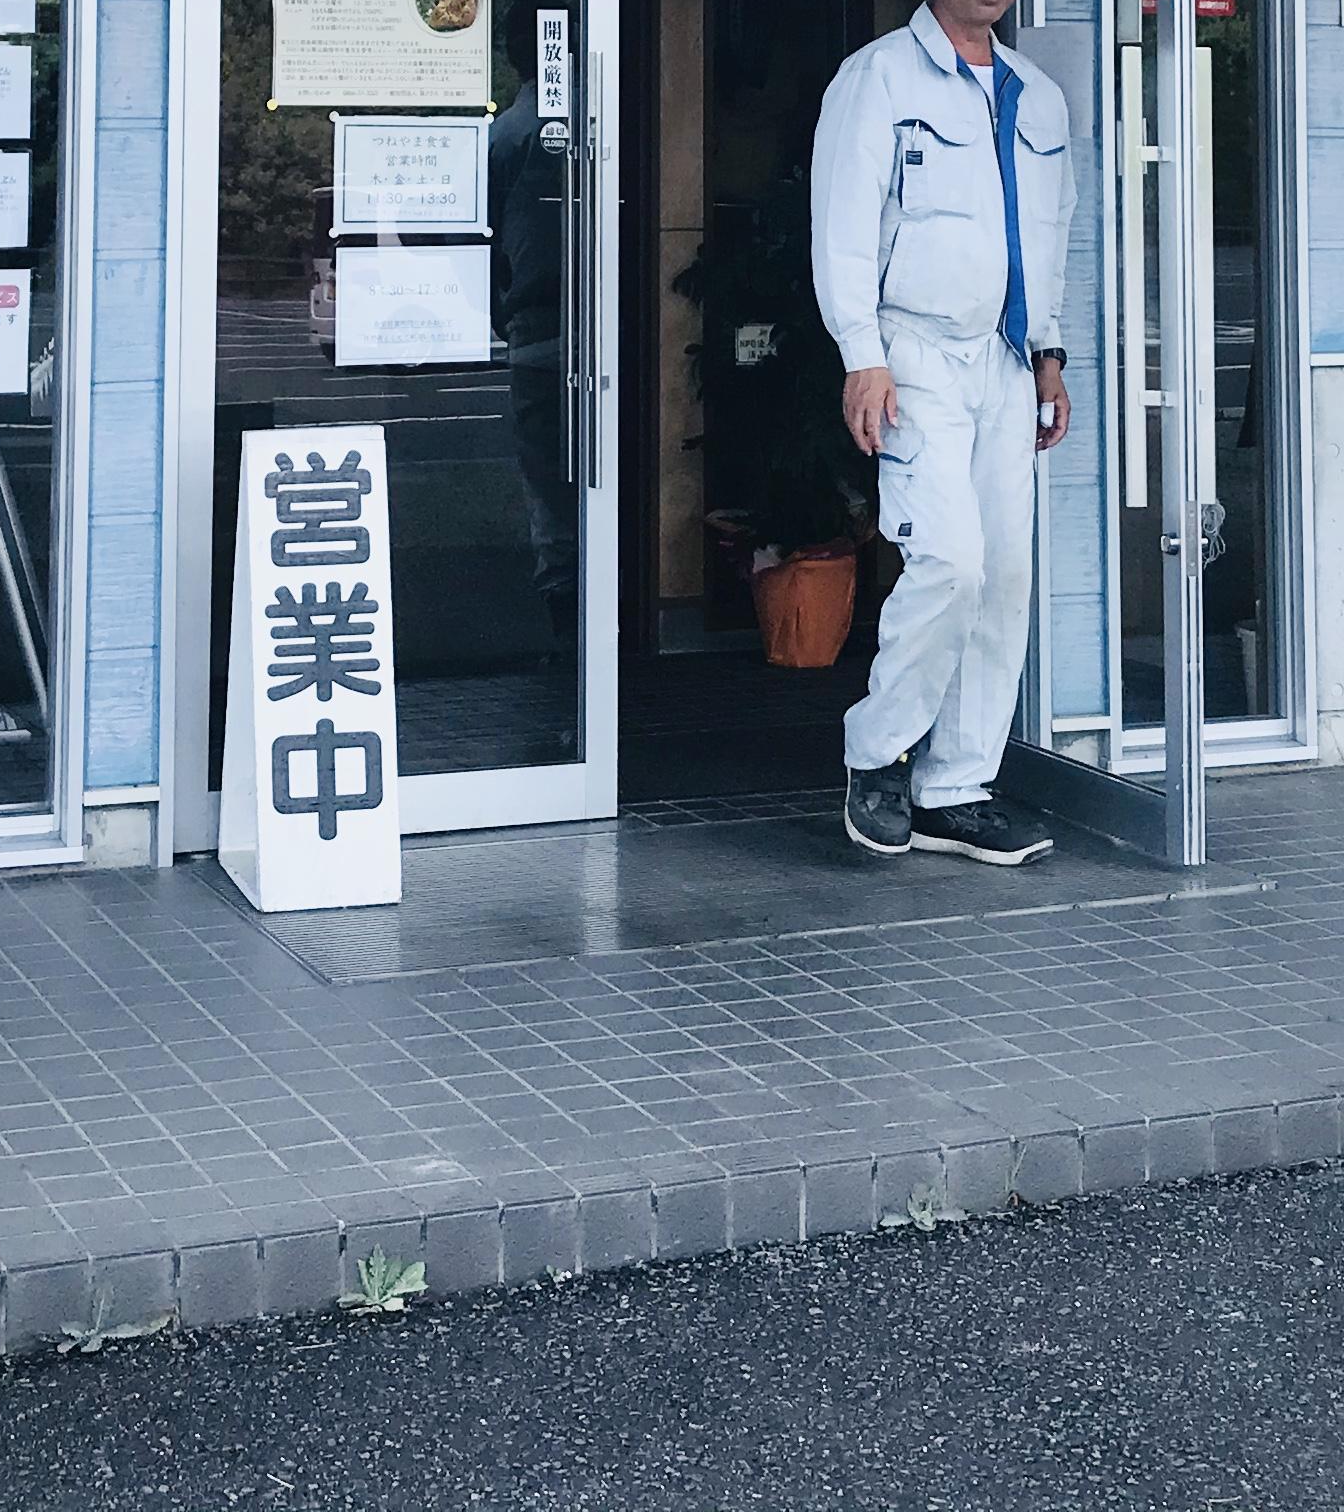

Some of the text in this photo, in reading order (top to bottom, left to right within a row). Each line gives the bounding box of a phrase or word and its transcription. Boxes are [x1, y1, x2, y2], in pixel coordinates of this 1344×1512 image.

[543, 20, 563, 108] 開放厳禁
[263, 449, 384, 841] 営業中
